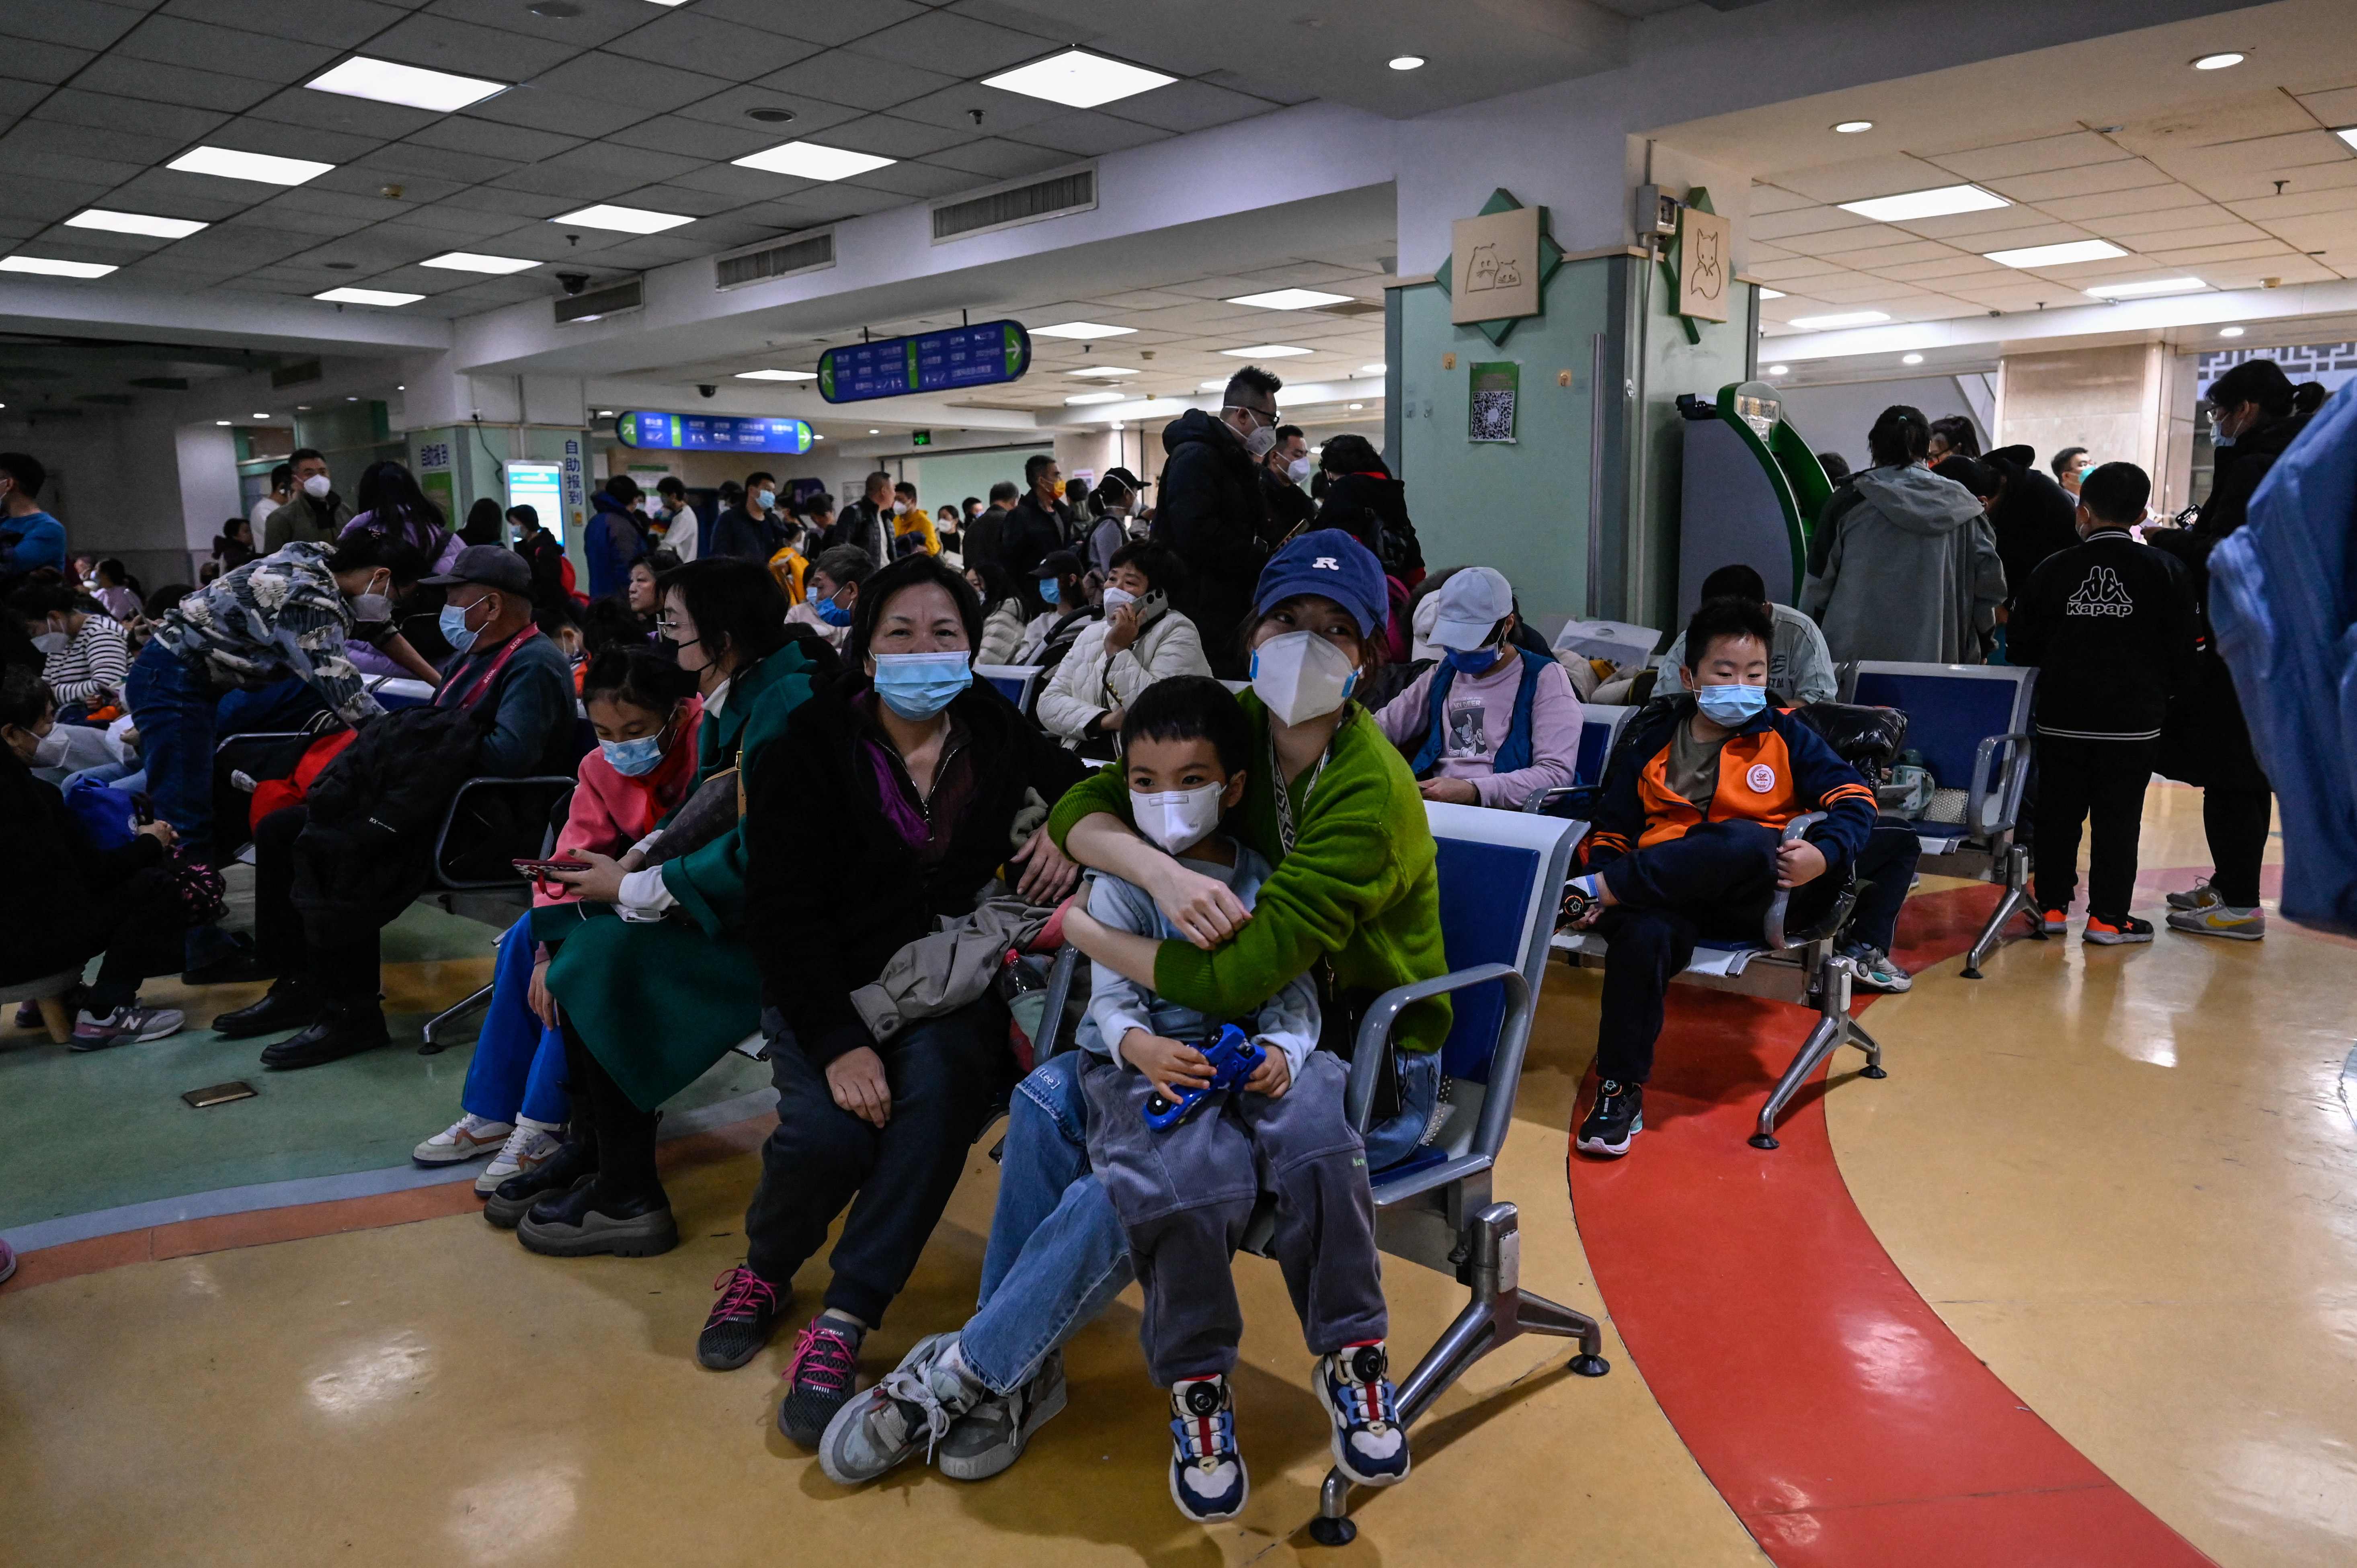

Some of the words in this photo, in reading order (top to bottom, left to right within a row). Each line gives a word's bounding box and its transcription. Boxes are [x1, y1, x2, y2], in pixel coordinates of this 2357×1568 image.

[565, 439, 583, 506] 自助报到
[1312, 557, 1339, 570] R
[2067, 602, 2133, 617] Kapap
